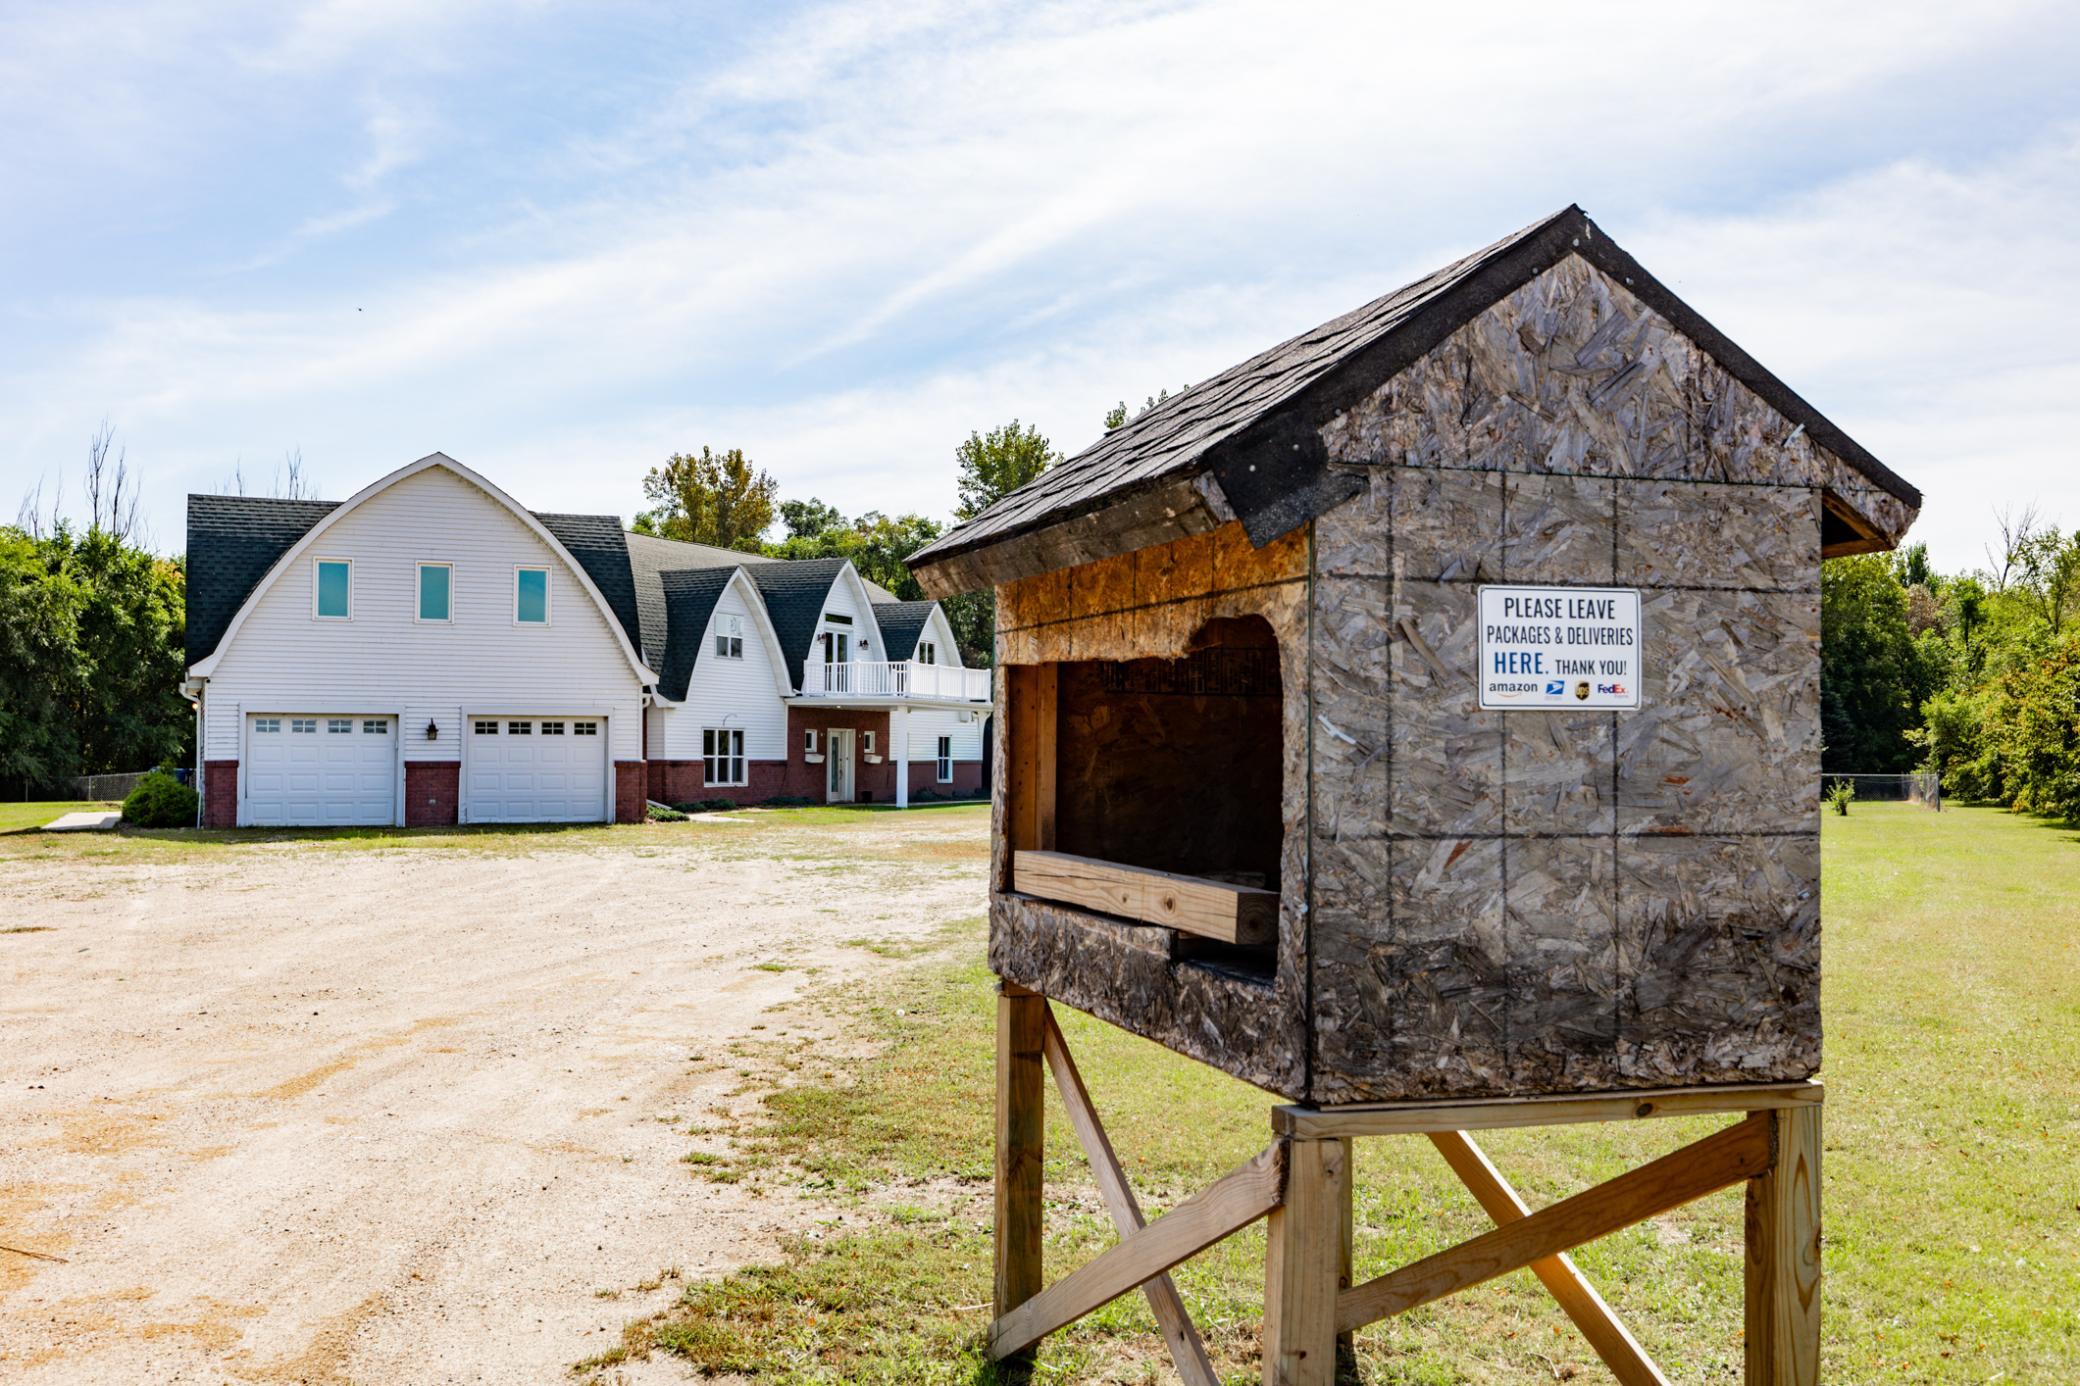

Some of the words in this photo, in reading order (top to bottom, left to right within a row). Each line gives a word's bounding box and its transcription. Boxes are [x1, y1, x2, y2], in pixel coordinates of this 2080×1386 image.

[1504, 597, 1562, 618] PLEASE
[1569, 599, 1615, 619] LEAVE
[1487, 625, 1550, 644] PACKAGES
[1554, 626, 1563, 644] &
[1567, 627, 1633, 645] DELIVERIES
[1494, 652, 1549, 674] HERE.
[1555, 659, 1595, 675] THANK
[1600, 660, 1627, 675] YOU!
[1489, 682, 1538, 692] amazon
[1597, 684, 1626, 694] FedEx
